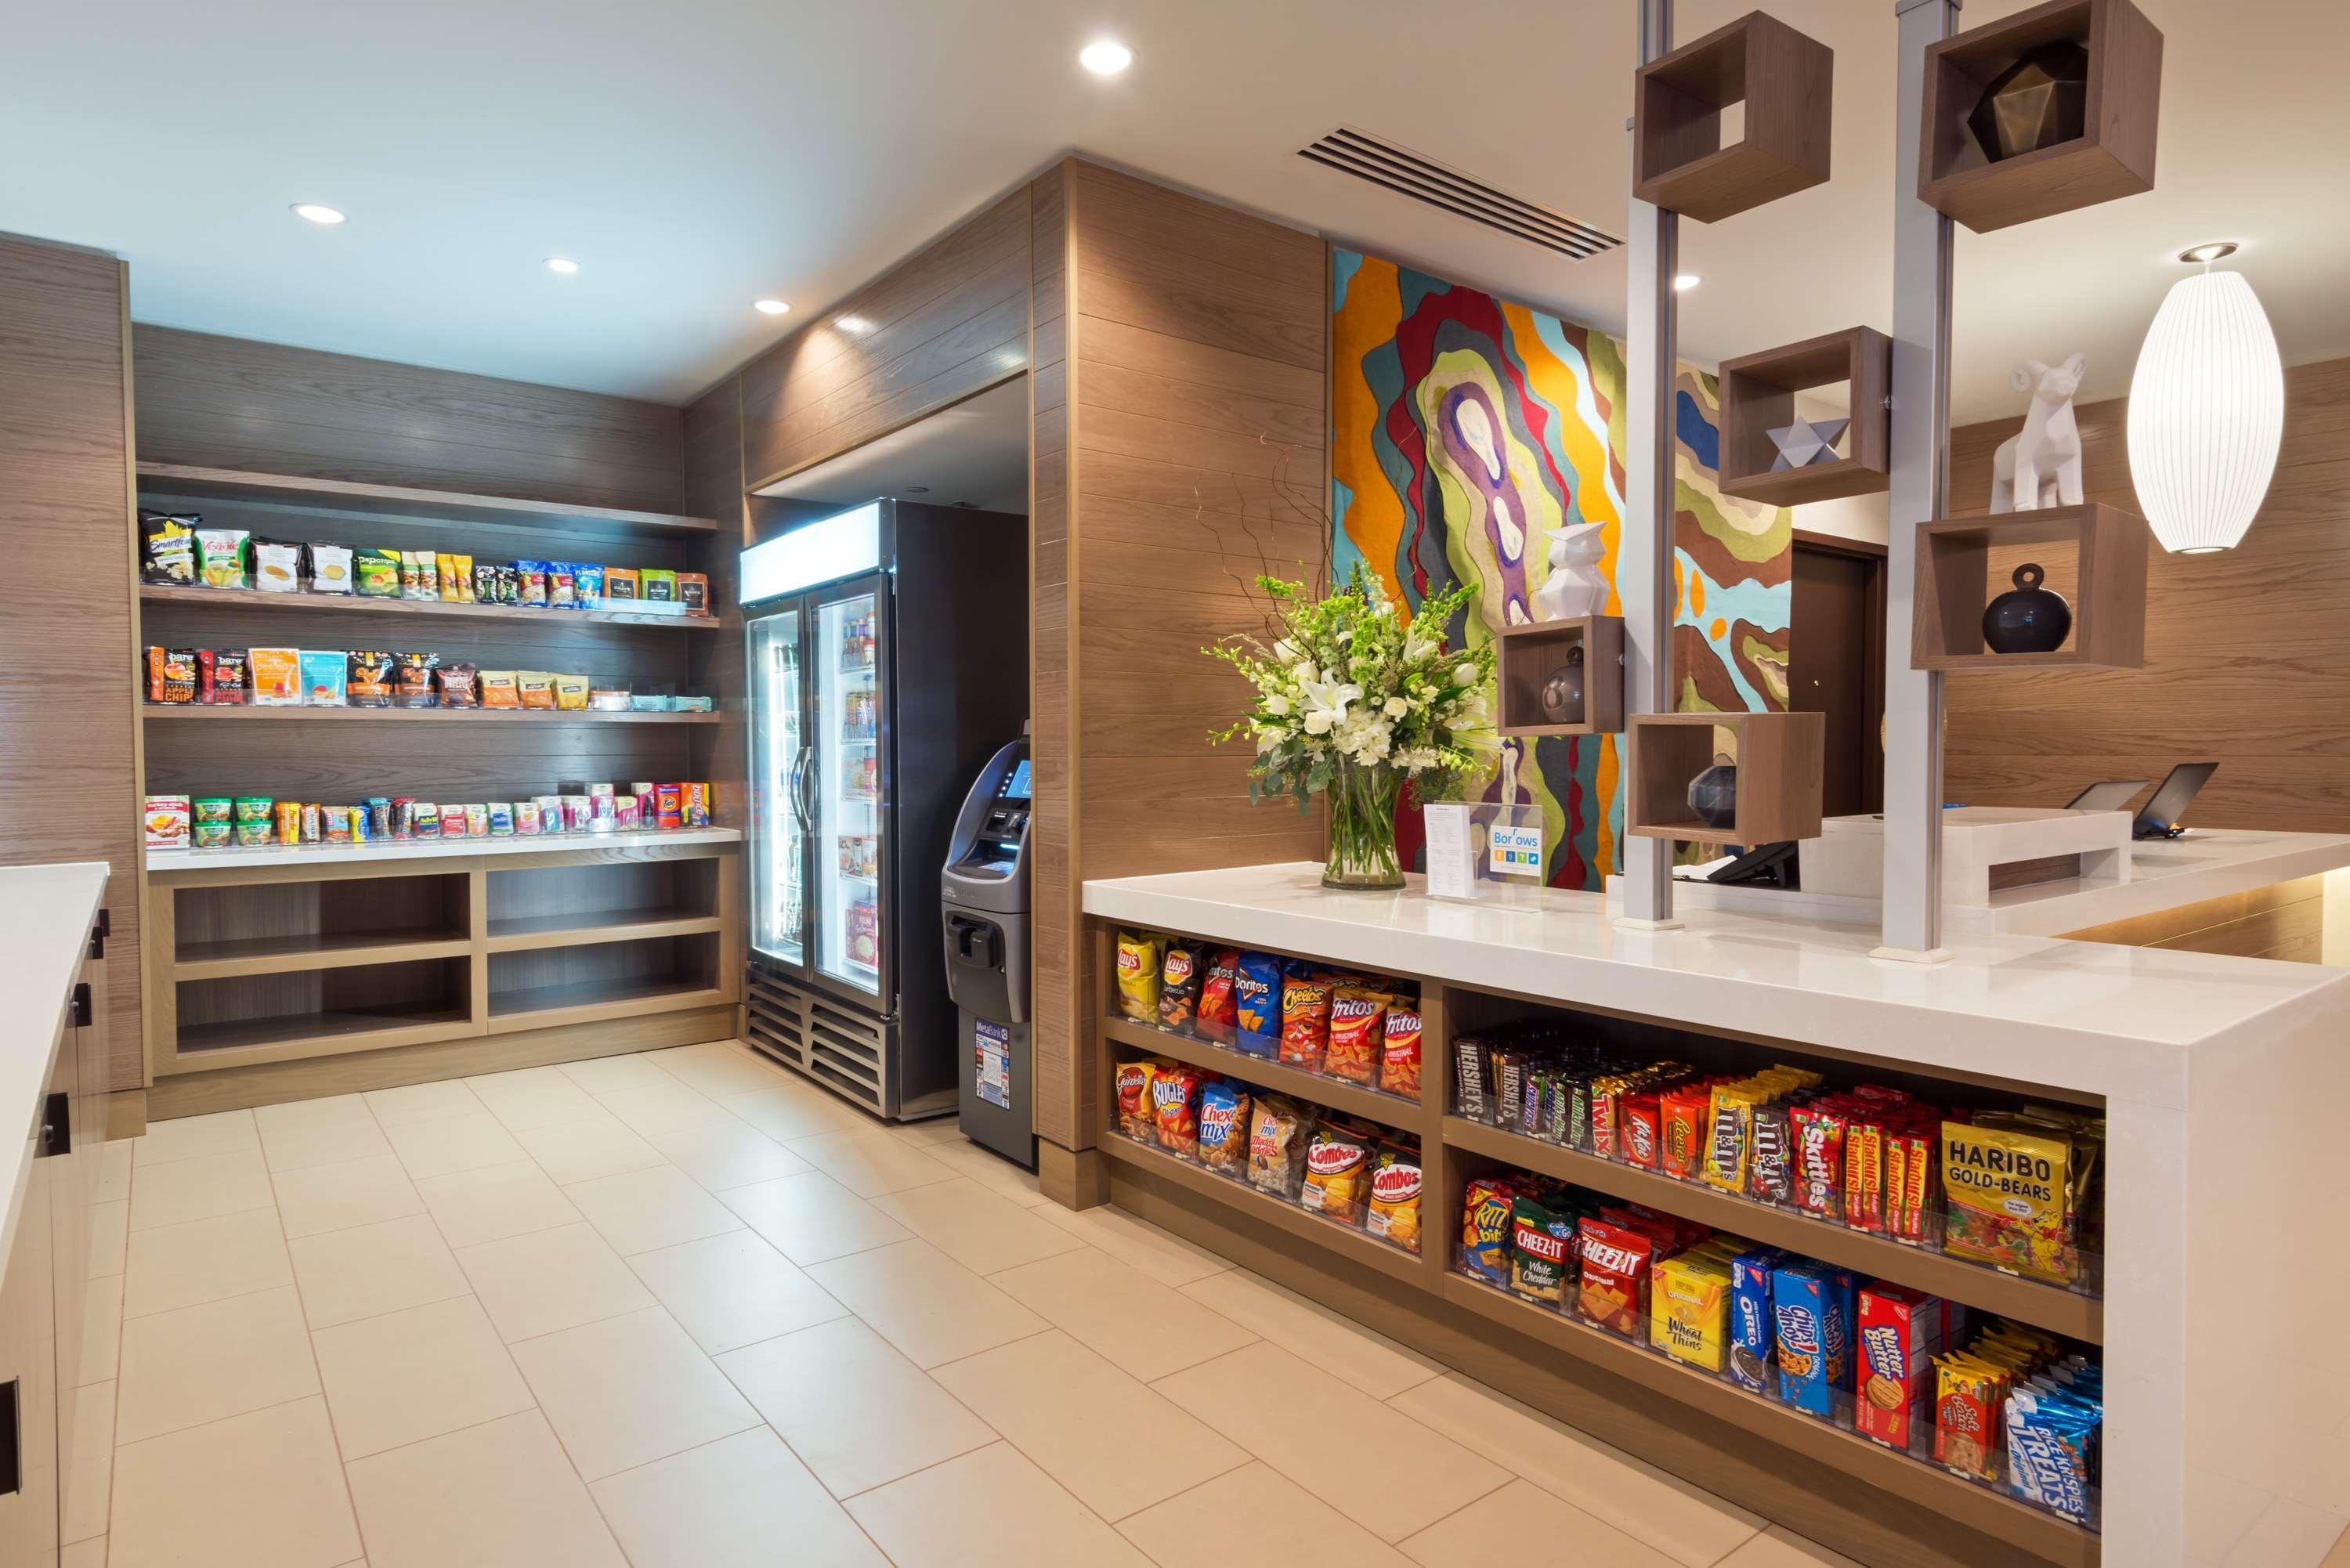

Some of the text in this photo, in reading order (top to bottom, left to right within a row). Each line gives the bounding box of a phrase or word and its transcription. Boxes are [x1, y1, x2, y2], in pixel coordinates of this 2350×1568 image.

[1495, 828, 1538, 847] Borrows
[1166, 954, 1188, 974] Lay's
[1235, 977, 1269, 994] Doritos
[1283, 988, 1325, 1012] Cheetos
[1332, 999, 1374, 1018] Fritos
[976, 1021, 1002, 1039] MetaBank
[1386, 1013, 1422, 1035] Fritos
[1460, 1045, 1483, 1114] HERSHEY'S
[1504, 1065, 1520, 1118] HERSHEY'S
[1153, 1080, 1186, 1110] BUGLES
[1524, 1085, 1535, 1129] SNICKERS
[1201, 1104, 1232, 1122] Chex
[1591, 1093, 1611, 1154] TWIX
[1674, 1115, 1691, 1165] Reese's
[1309, 1146, 1357, 1165] Combos
[1803, 1125, 1830, 1207] Skittles
[1949, 1140, 2051, 1182] HARIBO
[1373, 1167, 1420, 1191] Combos
[1949, 1167, 2051, 1201] GOLD-BEARS
[1475, 1202, 1509, 1228] RITZ
[1480, 1229, 1505, 1243] bits
[1522, 1271, 1557, 1287] Cheddar
[1528, 1259, 1553, 1275] White
[1668, 1316, 1703, 1342] Wheat
[1740, 1295, 1756, 1346] OREO
[1790, 1306, 1813, 1345] Chips
[1667, 1331, 1702, 1351] Thins
[1864, 1328, 1892, 1380] Butter
[1878, 1327, 1904, 1379] Nutter
[2008, 1424, 2067, 1510] TREATS
[2036, 1427, 2084, 1515] RICE KRISPIES
